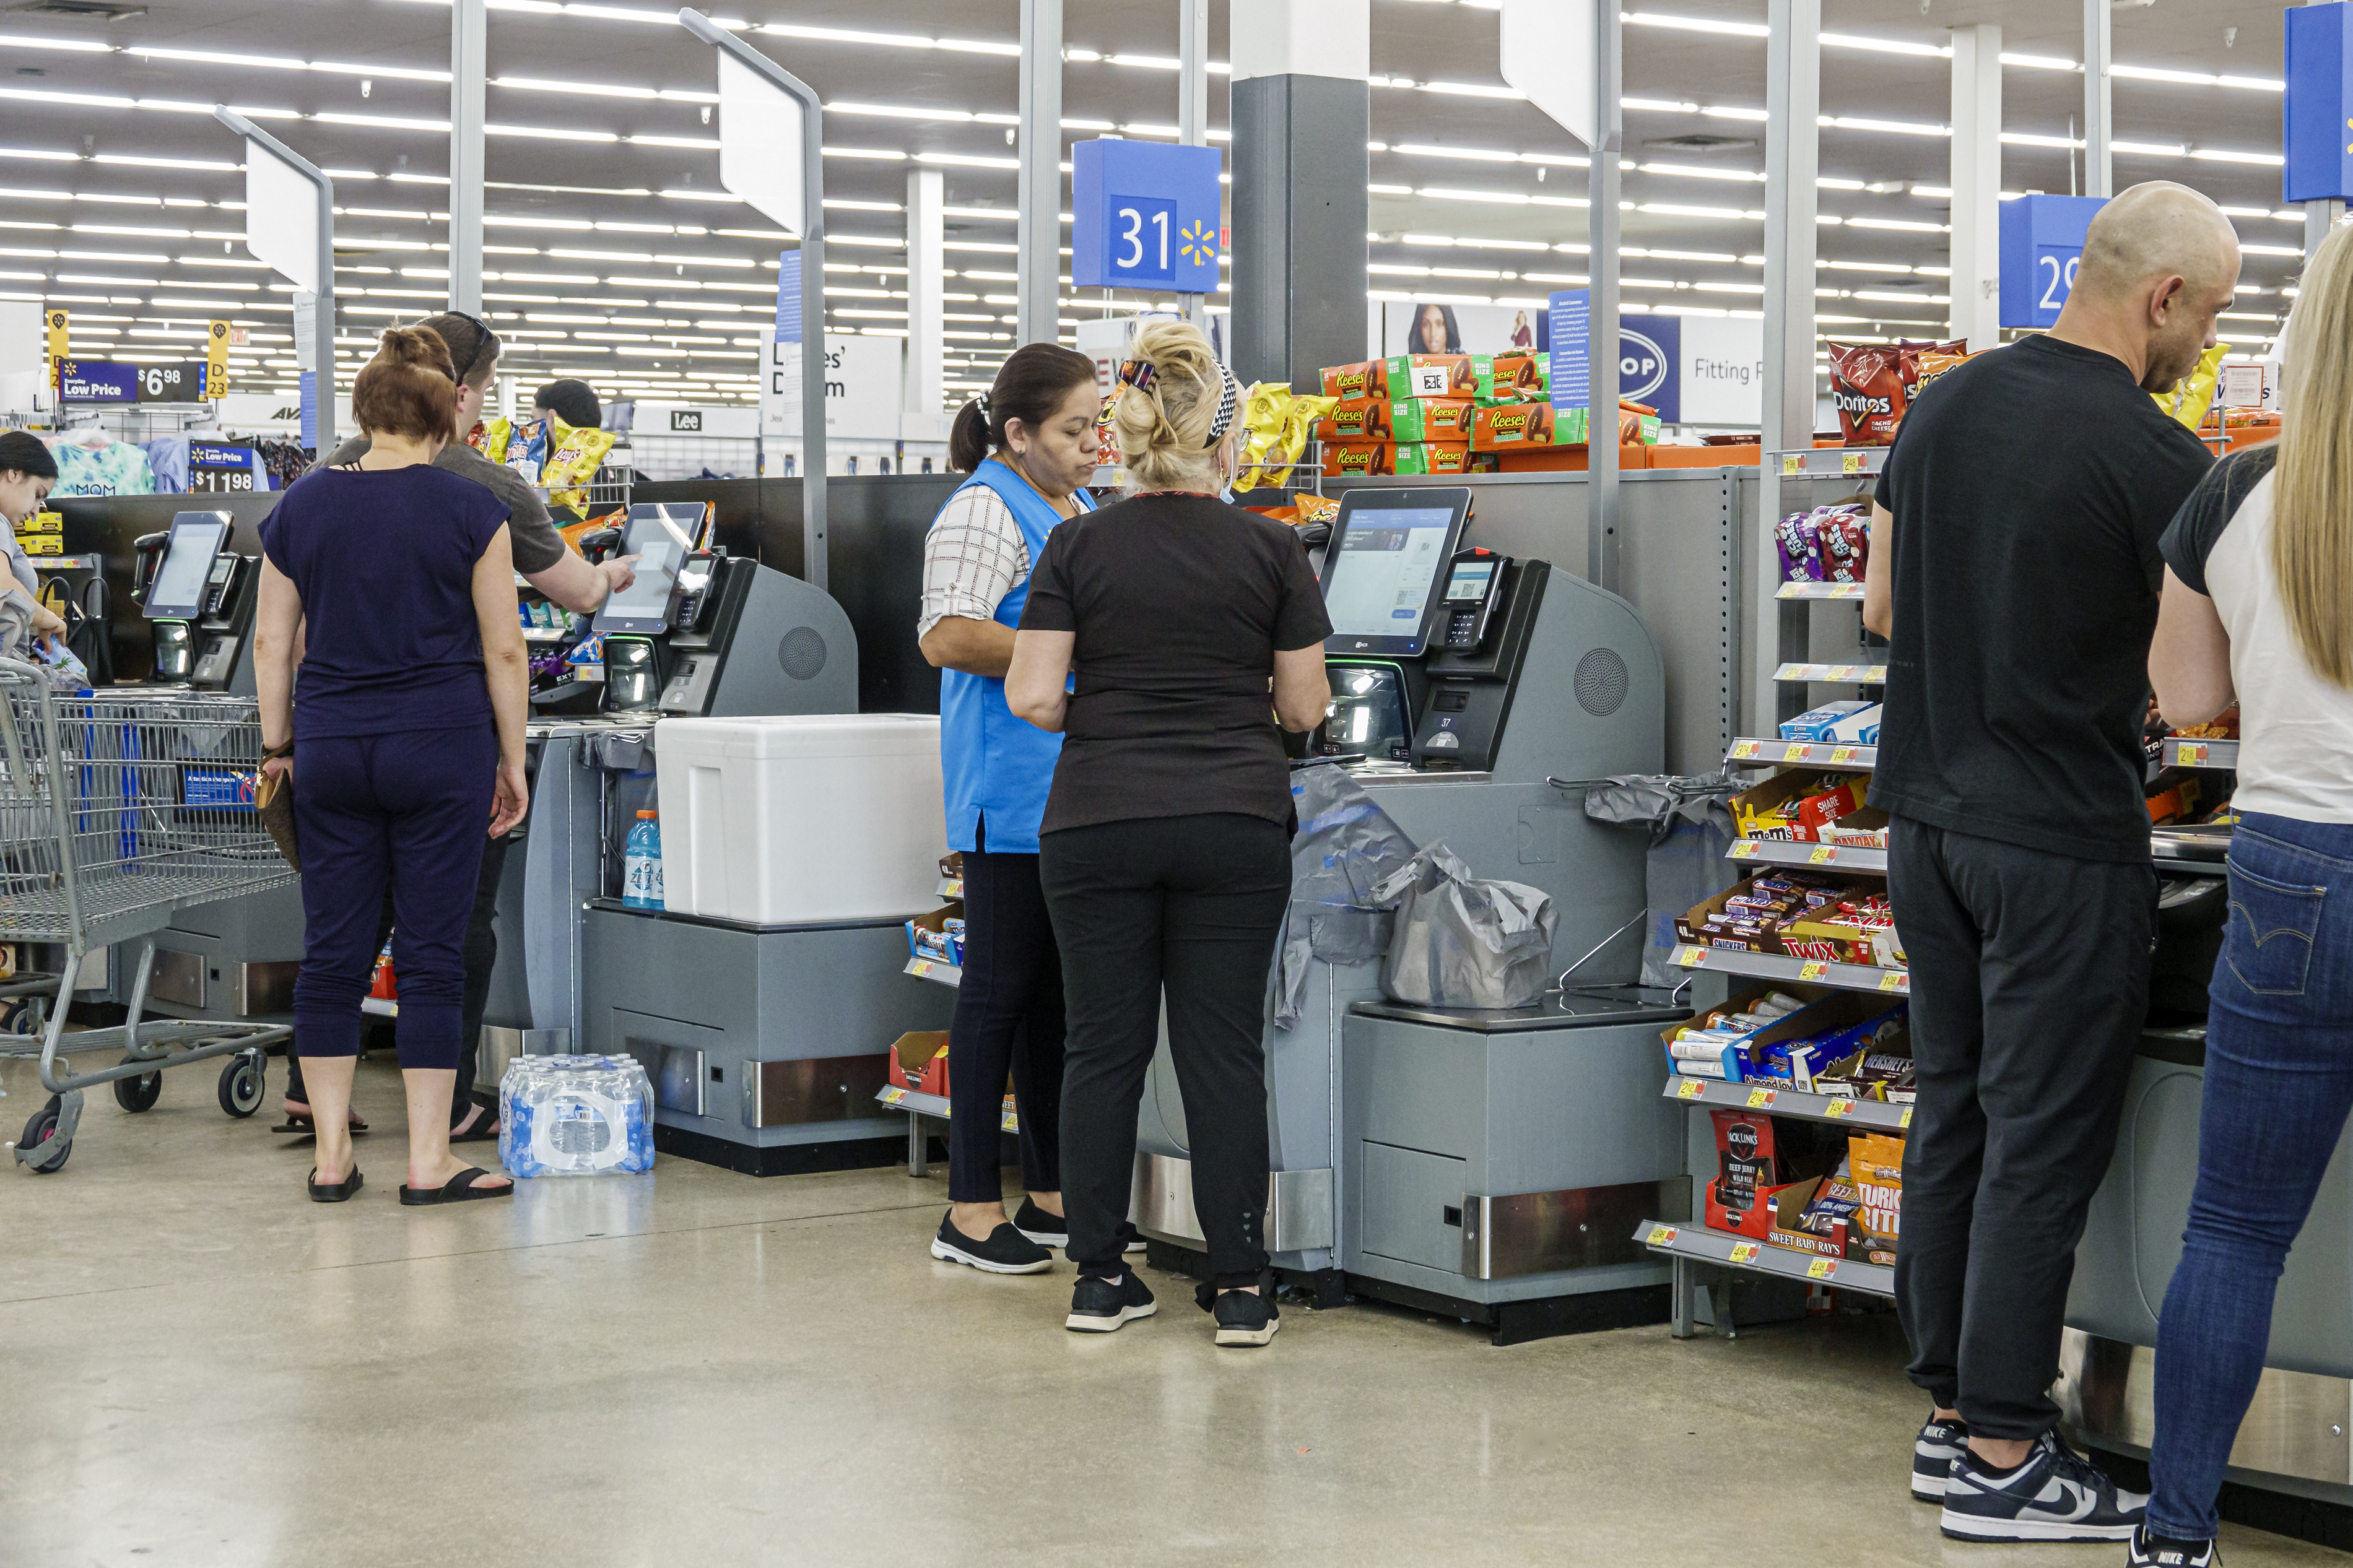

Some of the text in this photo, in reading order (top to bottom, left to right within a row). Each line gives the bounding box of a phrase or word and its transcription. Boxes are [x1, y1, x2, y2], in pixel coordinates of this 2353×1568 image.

[1117, 208, 1168, 269] 31
[212, 364, 224, 376] D
[1494, 369, 1516, 379] eese's
[1695, 358, 1749, 384] Fitting
[1336, 370, 1365, 389] Reese's
[64, 384, 122, 396] Low Price
[209, 382, 224, 394] 23
[1342, 390, 1365, 401] FOOTBALLS
[1833, 391, 1890, 413] Doritos
[1331, 405, 1364, 422] Reese's
[1431, 405, 1459, 417] Reese's
[676, 413, 698, 431] Lee
[1490, 410, 1527, 428] Reese's
[1336, 427, 1364, 435] FOOTBALLS
[1643, 430, 1658, 438] SIZE
[1494, 433, 1523, 443] FOOTBALLS
[206, 452, 243, 462] Low Price
[552, 448, 581, 464] Lay's
[1337, 448, 1369, 464] Reese's
[1434, 448, 1461, 461] Reese's
[76, 484, 116, 496] MOM
[1442, 718, 1451, 727] 37
[1817, 795, 1840, 813] SHARE
[1825, 808, 1837, 820] SIZE
[1793, 825, 1806, 833] SHARE
[942, 865, 949, 874] 48
[1679, 925, 1689, 937] 48
[1714, 939, 1746, 951] SNICKERS
[1864, 1054, 1913, 1072] HERSHEY'S
[1727, 1131, 1758, 1145] JACK LINK'S
[1729, 1163, 1755, 1174] BEEF JERKY
[1827, 1182, 1853, 1198] BEEF
[1769, 1231, 1840, 1255] SWEET BABY RAY'S
[1924, 1425, 1946, 1439] NIKE
[2158, 1551, 2183, 1566] NIKE
